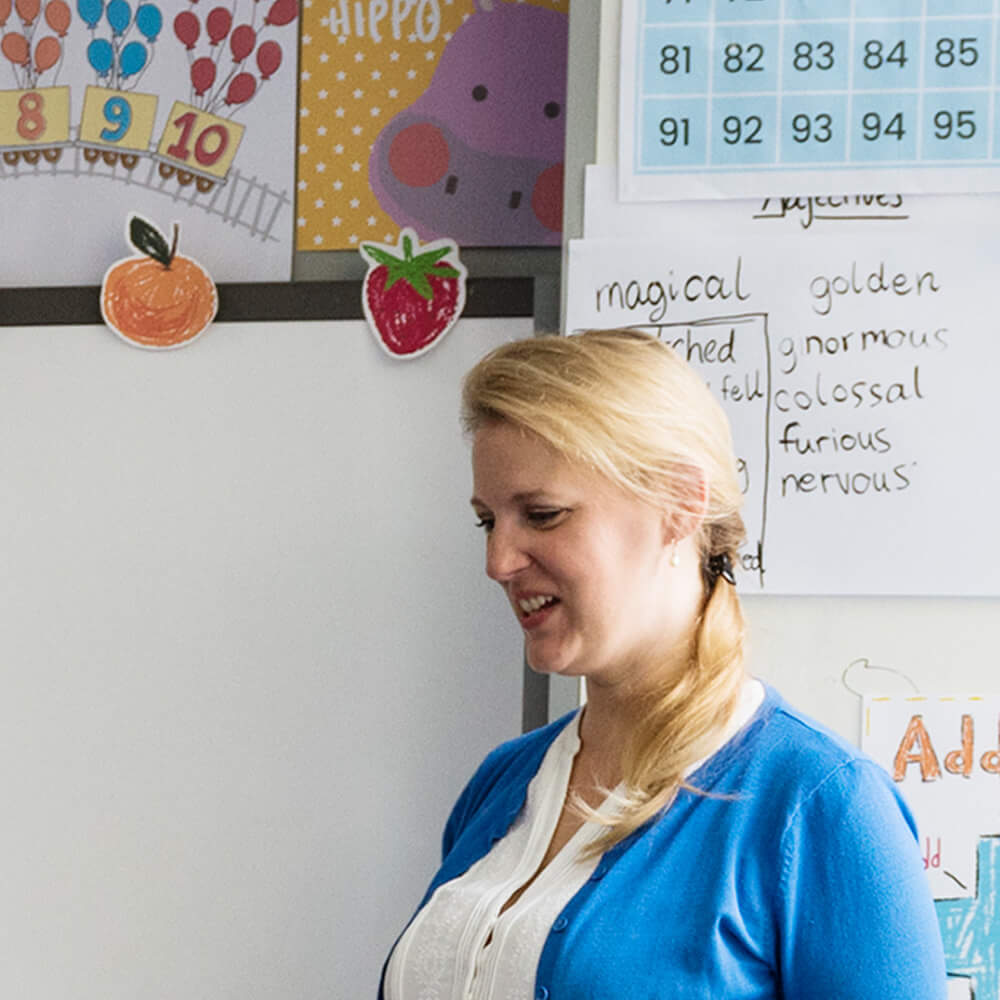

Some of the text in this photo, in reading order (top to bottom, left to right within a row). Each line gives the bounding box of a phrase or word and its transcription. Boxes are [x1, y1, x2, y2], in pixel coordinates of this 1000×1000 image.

[328, 0, 441, 43] HIPPO
[659, 37, 979, 75] 81 82 83 84 85
[15, 92, 47, 141] 8
[100, 96, 133, 143] 9
[166, 111, 231, 167] 10
[659, 109, 977, 147] 91 92 93 94 95
[596, 256, 751, 323] magical
[809, 261, 942, 316] golden
[774, 365, 924, 412] colossal
[778, 420, 892, 455] furious
[781, 463, 911, 497] nervous
